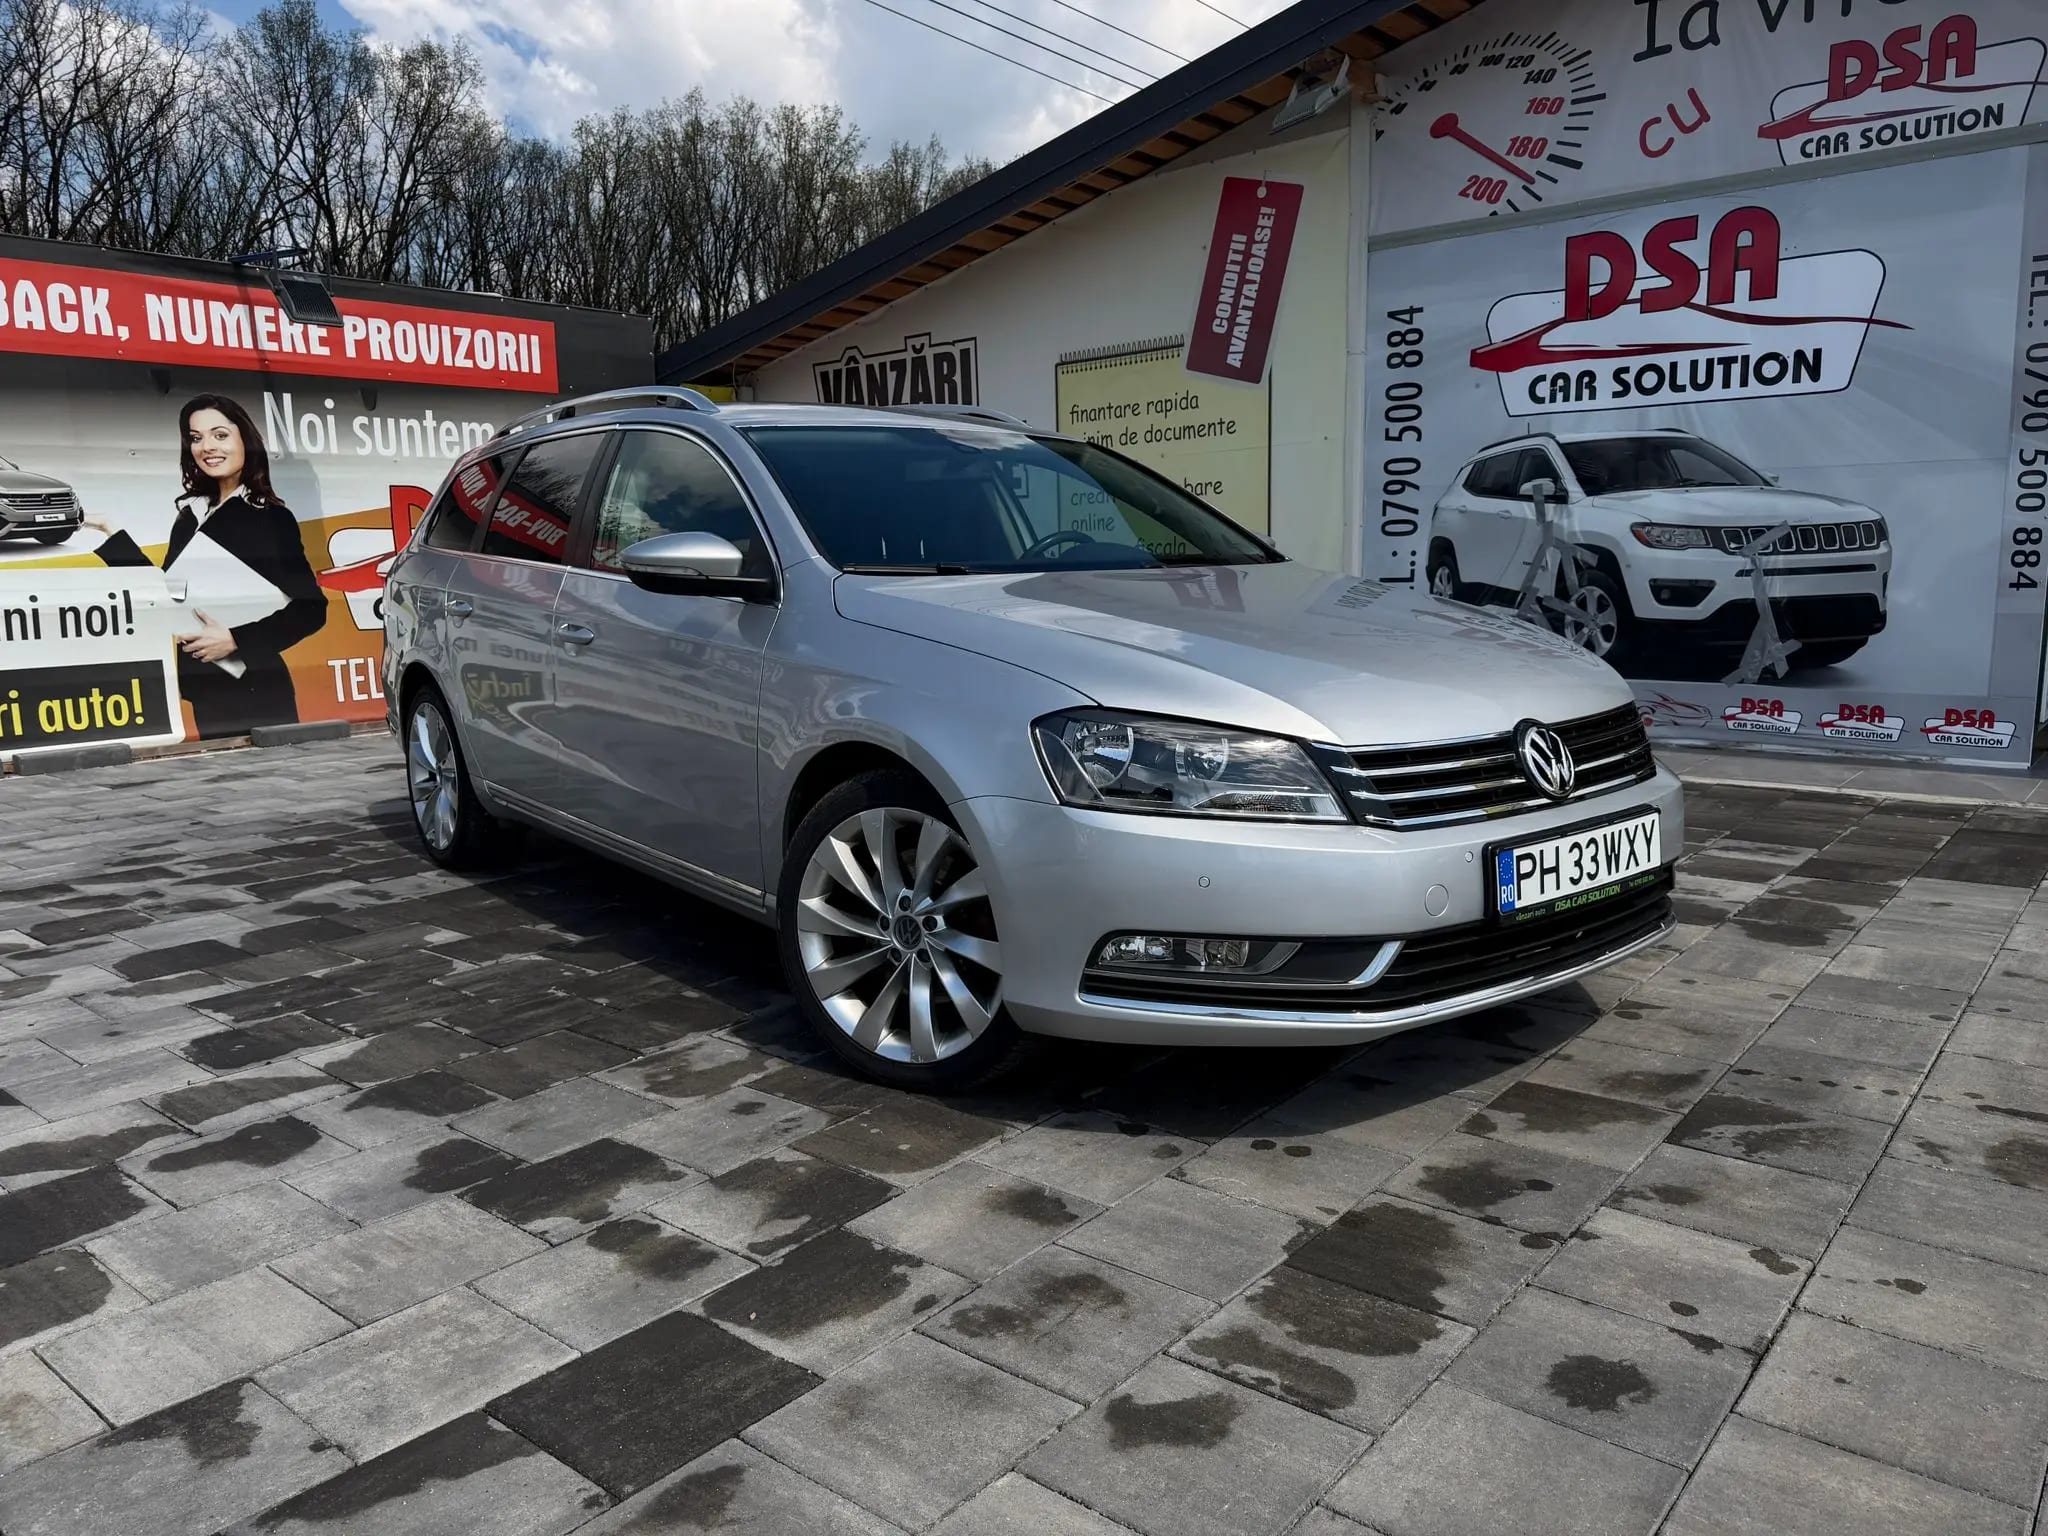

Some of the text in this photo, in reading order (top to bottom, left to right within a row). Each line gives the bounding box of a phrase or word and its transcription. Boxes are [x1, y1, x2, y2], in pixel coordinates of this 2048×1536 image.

[1505, 54, 1536, 69] 120
[1523, 68, 1558, 84] 140
[1827, 14, 1978, 101] DSA
[1524, 96, 1565, 115] 160
[1638, 87, 1711, 158] cu
[1504, 136, 1548, 159] 180
[1800, 102, 2005, 159] CAR SOLUTION
[1458, 174, 1508, 205] 200
[1226, 206, 1276, 368] AVANTAJOASE!
[1565, 206, 1780, 322] DSA
[144, 293, 331, 357] NUMERE
[344, 315, 542, 375] PROVIZORII
[1386, 305, 1424, 369] 884
[819, 342, 973, 407] VÂNZĂRI
[1528, 347, 1823, 405] CAR SOLUTION
[263, 391, 339, 455] Noi
[352, 409, 496, 458] suntem
[1069, 389, 1199, 425] finantare rapida
[1119, 425, 1139, 446] de
[1143, 416, 1237, 444] documente
[1384, 382, 1423, 442] 500
[1381, 457, 1421, 537] 0790
[2015, 448, 2048, 512] 500
[1071, 513, 1115, 532] online
[2009, 526, 2043, 592] 884
[0, 589, 135, 641] ni noi!
[328, 657, 384, 703] TEL
[38, 678, 145, 734] auto!
[1732, 722, 1791, 732] CAR SOLUTION
[1741, 697, 1784, 717] DSA
[1838, 704, 1885, 724] DSA
[1945, 708, 1995, 728] DSA
[1829, 728, 1893, 740] CAR SOLUTION
[1935, 734, 2004, 746] CAR SOLUTION
[1516, 819, 1656, 901] PH 33 WXY
[1501, 883, 1514, 905] RO
[1555, 884, 1621, 912] DSA CAR SOLUTION
